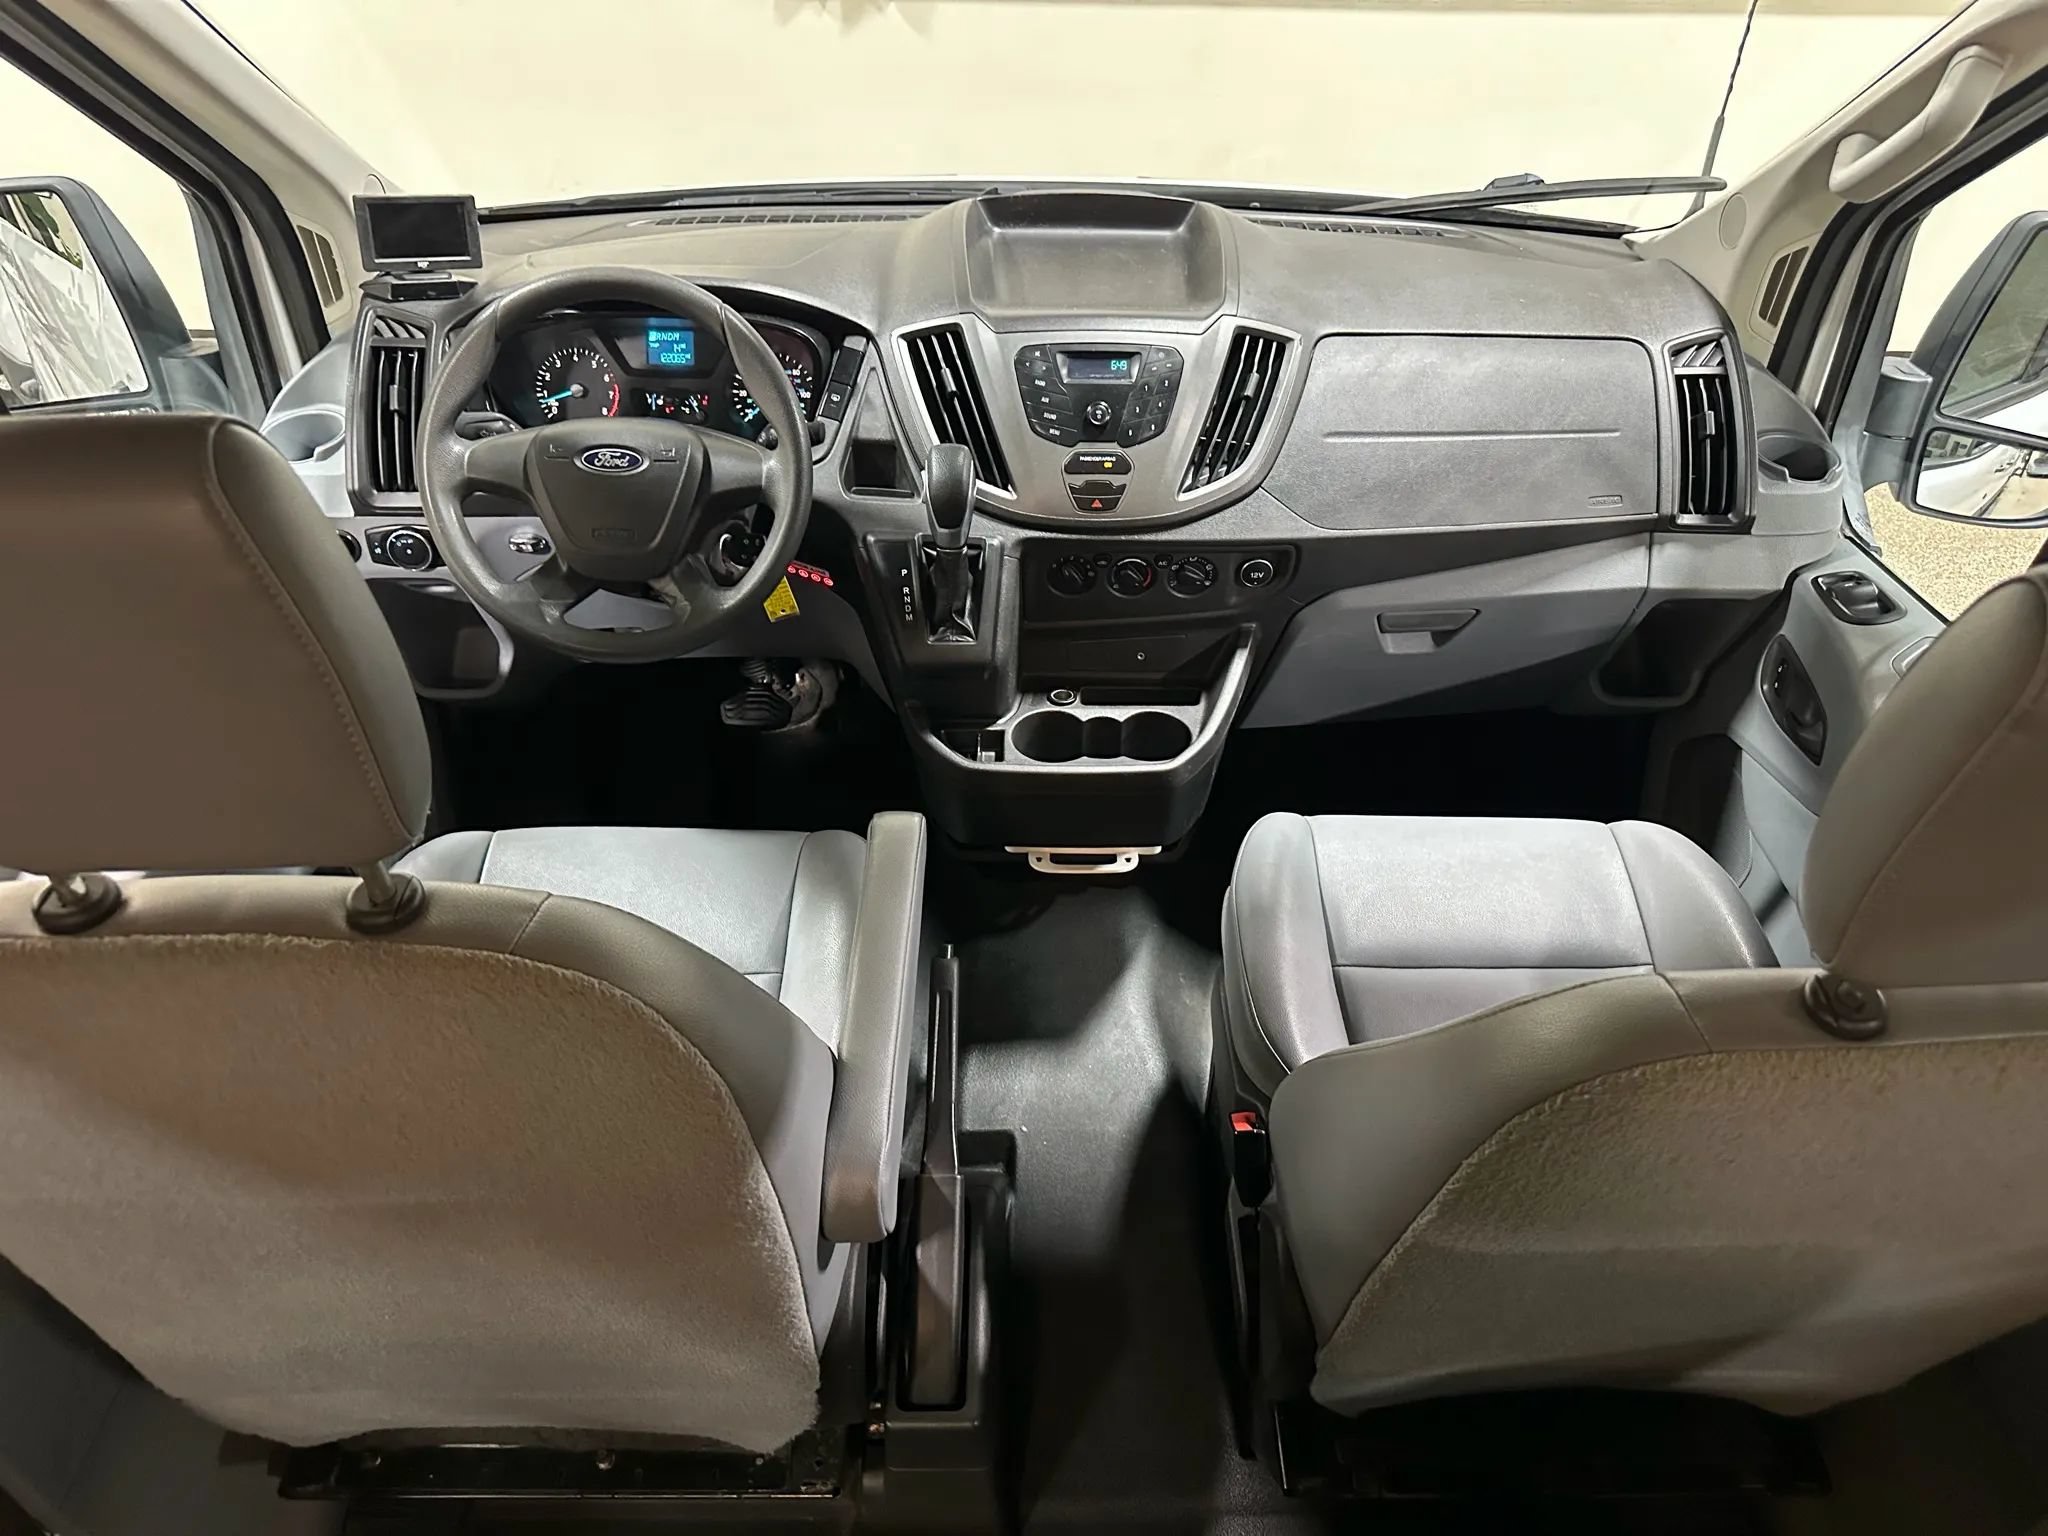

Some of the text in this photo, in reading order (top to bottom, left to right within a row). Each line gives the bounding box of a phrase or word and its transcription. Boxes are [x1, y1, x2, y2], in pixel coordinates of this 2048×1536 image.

[591, 360, 597, 368] 5
[545, 373, 551, 381] 2
[603, 374, 609, 382] 6
[594, 451, 629, 467] Ford
[905, 604, 911, 612] D
[905, 613, 913, 621] M
